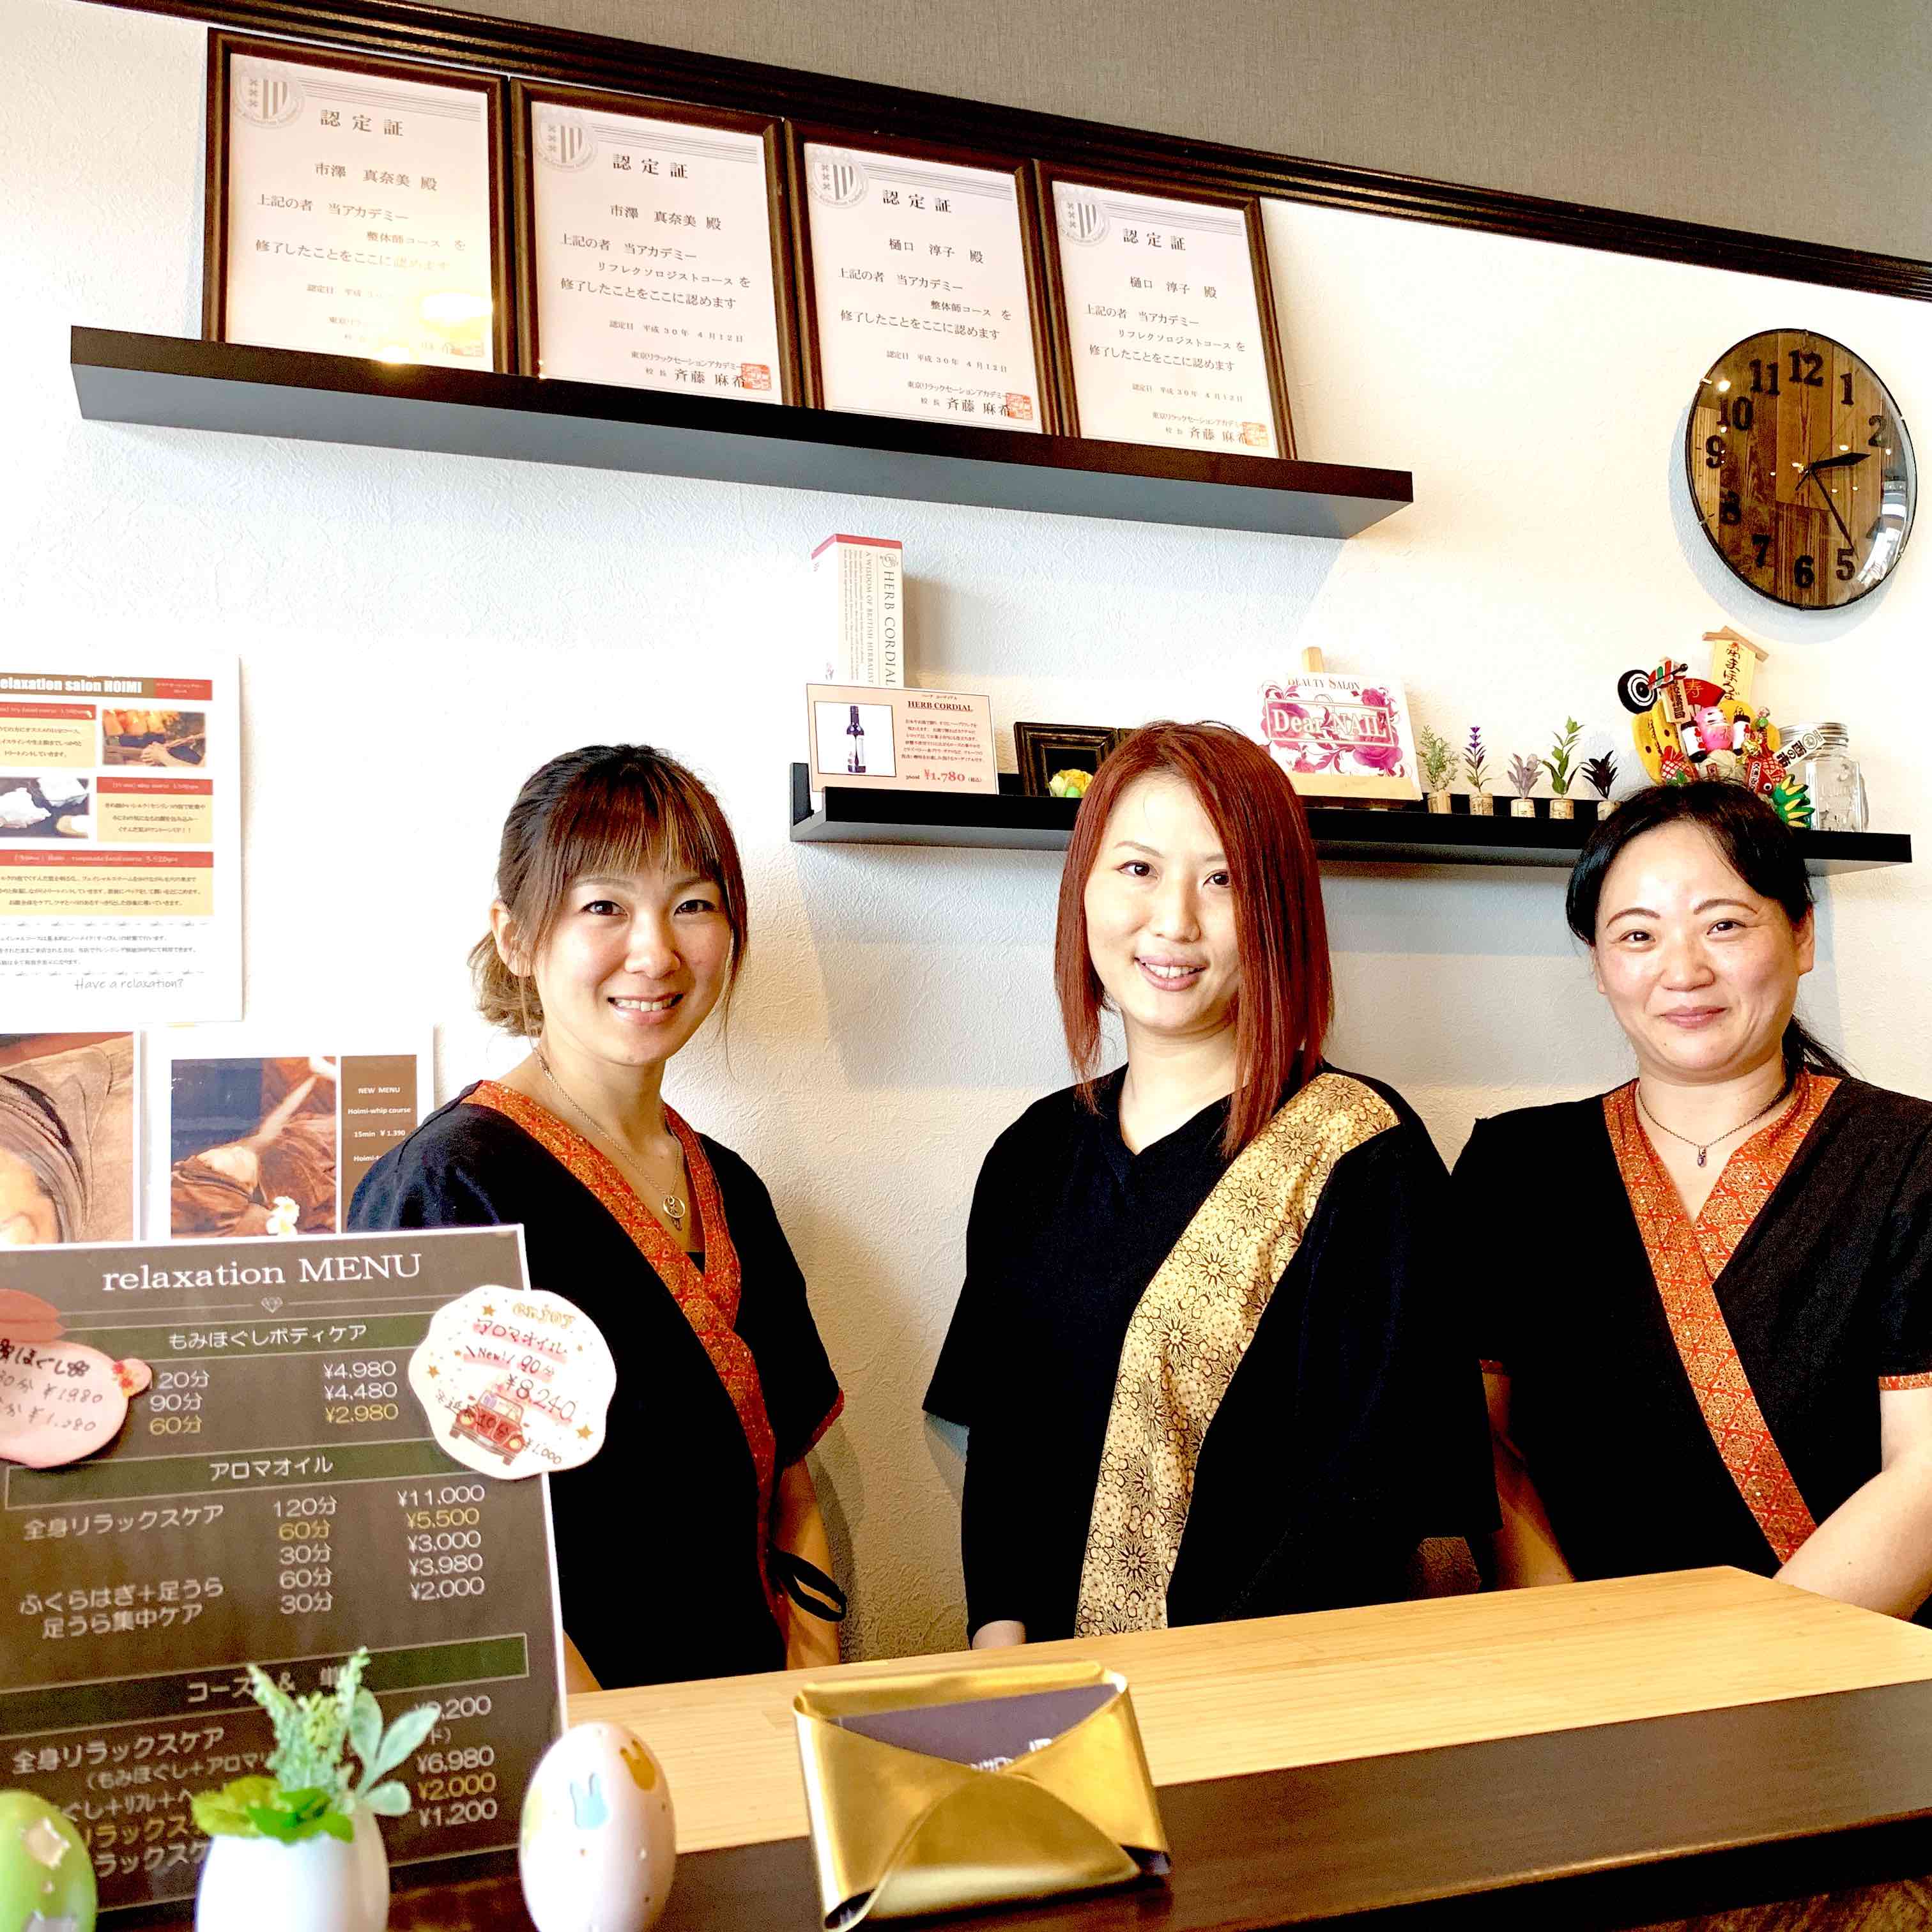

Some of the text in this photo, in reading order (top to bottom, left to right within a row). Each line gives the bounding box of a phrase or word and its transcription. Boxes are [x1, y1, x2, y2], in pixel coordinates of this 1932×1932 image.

[321, 109, 404, 137] 認定証
[611, 153, 688, 180] 認定証
[363, 169, 410, 187] 真奈美
[421, 175, 438, 192] 殿
[257, 194, 409, 221] 上記の者 当アカデミー
[882, 189, 952, 214] 認定証
[654, 210, 696, 228] 真奈美
[706, 216, 721, 231] 殿
[560, 233, 697, 261] 上記の者 当アカデミー
[889, 237, 984, 264] 樋口 淳子 殿
[1123, 228, 1186, 250] 認定証
[597, 261, 751, 288] リフレクソロジストコース を
[838, 267, 963, 292] 上記の者 当アカデミー
[1130, 275, 1217, 299] 樋口 淳子 殿
[560, 277, 736, 309] 修了したことをここに認めます
[930, 300, 1012, 321] 整体師コース を
[1085, 303, 1199, 326] 上記の者 当アカデミー
[840, 309, 1000, 340] 修了したことをここに認めます
[1089, 344, 1236, 372] 修了したことをここに認めます
[1236, 341, 1246, 352] を
[1749, 358, 1780, 395] 11
[1789, 349, 1824, 387] 12
[1839, 372, 1854, 405] 1
[1716, 395, 1754, 431] 10
[1868, 415, 1889, 448] 2
[1705, 434, 1725, 469] 9
[1718, 490, 1742, 525] 8
[1751, 533, 1771, 568] 7
[1794, 555, 1815, 588] 6
[1836, 547, 1856, 581] 5
[883, 571, 897, 687] HERB CORDIAL
[65, 678, 102, 692] salon
[104, 680, 143, 693] HOIMI
[1328, 677, 1361, 690] SALON
[1685, 680, 1704, 699] 寿
[907, 701, 973, 712] HERB CORDIAL
[1271, 709, 1322, 734] Dear
[74, 978, 105, 991] Have
[120, 977, 184, 989] relaxation?
[102, 1252, 422, 1291] relaxation MENU
[150, 1392, 203, 1413] 90分
[149, 1414, 203, 1436] 60分
[210, 1456, 334, 1482] アロマオイル
[23, 1503, 225, 1542] 全身リラックスケア
[273, 1496, 337, 1517] 120分
[279, 1519, 331, 1542] 60分
[279, 1543, 332, 1565] 30分
[279, 1567, 334, 1589] 60分
[280, 1591, 334, 1614] 30分
[279, 1671, 296, 1692] &
[12, 1726, 226, 1775] 全身リラックスケア
